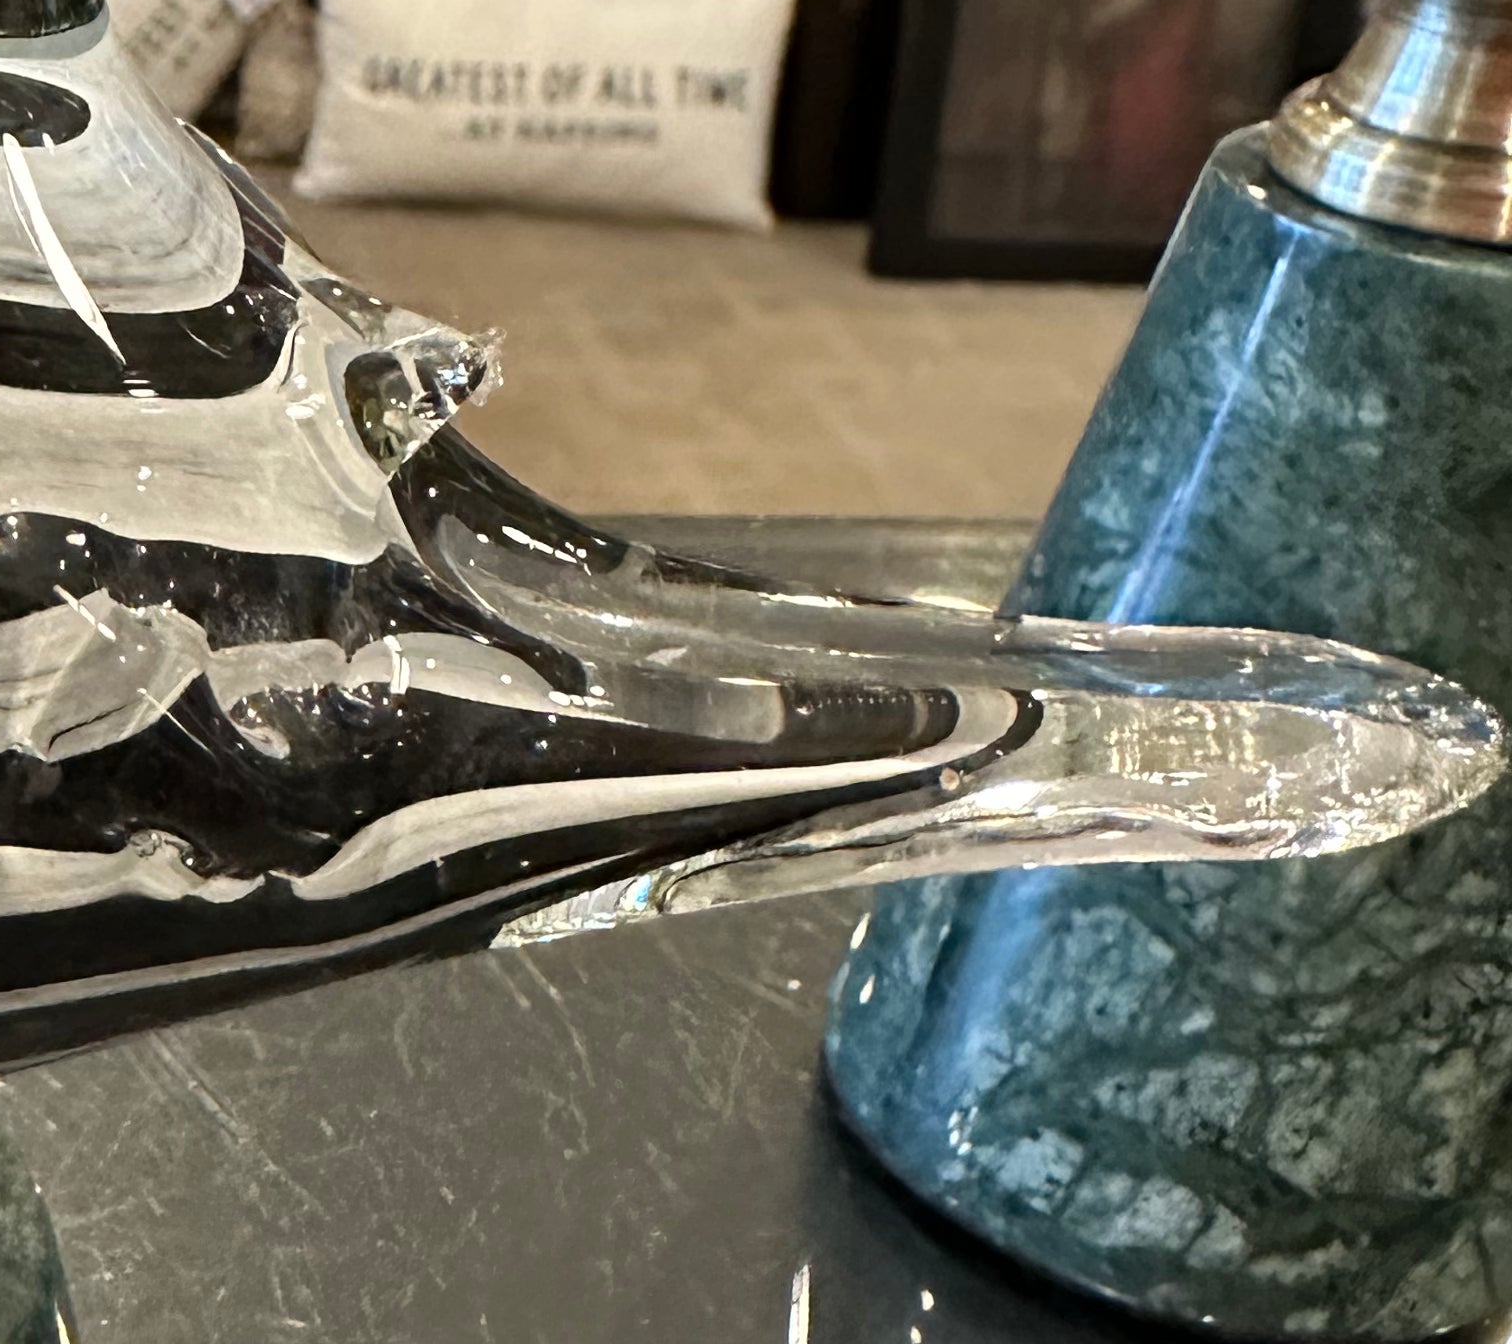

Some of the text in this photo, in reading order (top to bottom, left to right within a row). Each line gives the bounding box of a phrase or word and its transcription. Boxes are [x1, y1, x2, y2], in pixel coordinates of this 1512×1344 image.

[361, 54, 749, 113] GREATEST OF ALL TIME
